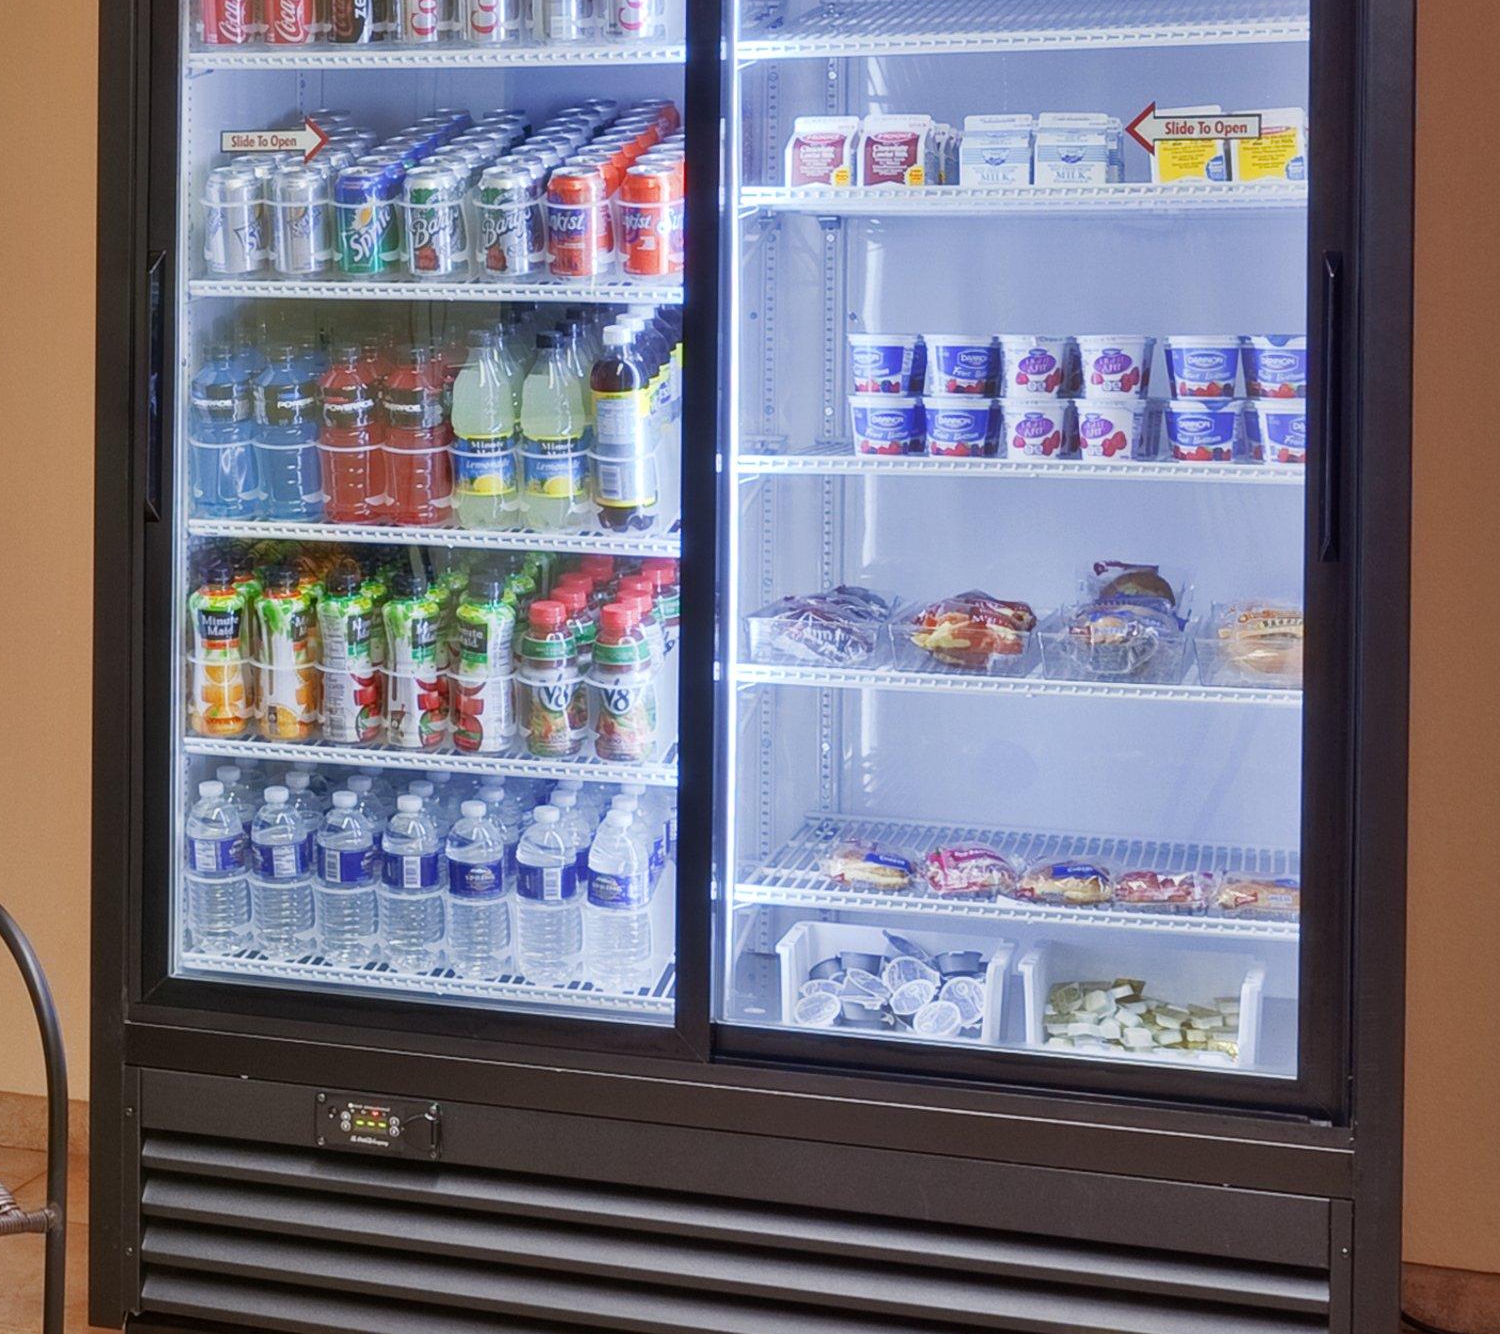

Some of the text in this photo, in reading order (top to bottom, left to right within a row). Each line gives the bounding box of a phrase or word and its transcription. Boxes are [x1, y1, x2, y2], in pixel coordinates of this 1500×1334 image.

[1165, 120, 1248, 137] Slide To Open
[231, 134, 297, 150] Slide To Open
[201, 613, 239, 627] Minute
[207, 623, 234, 636] Maid
[542, 673, 569, 708] V8
[603, 678, 630, 712] V8
